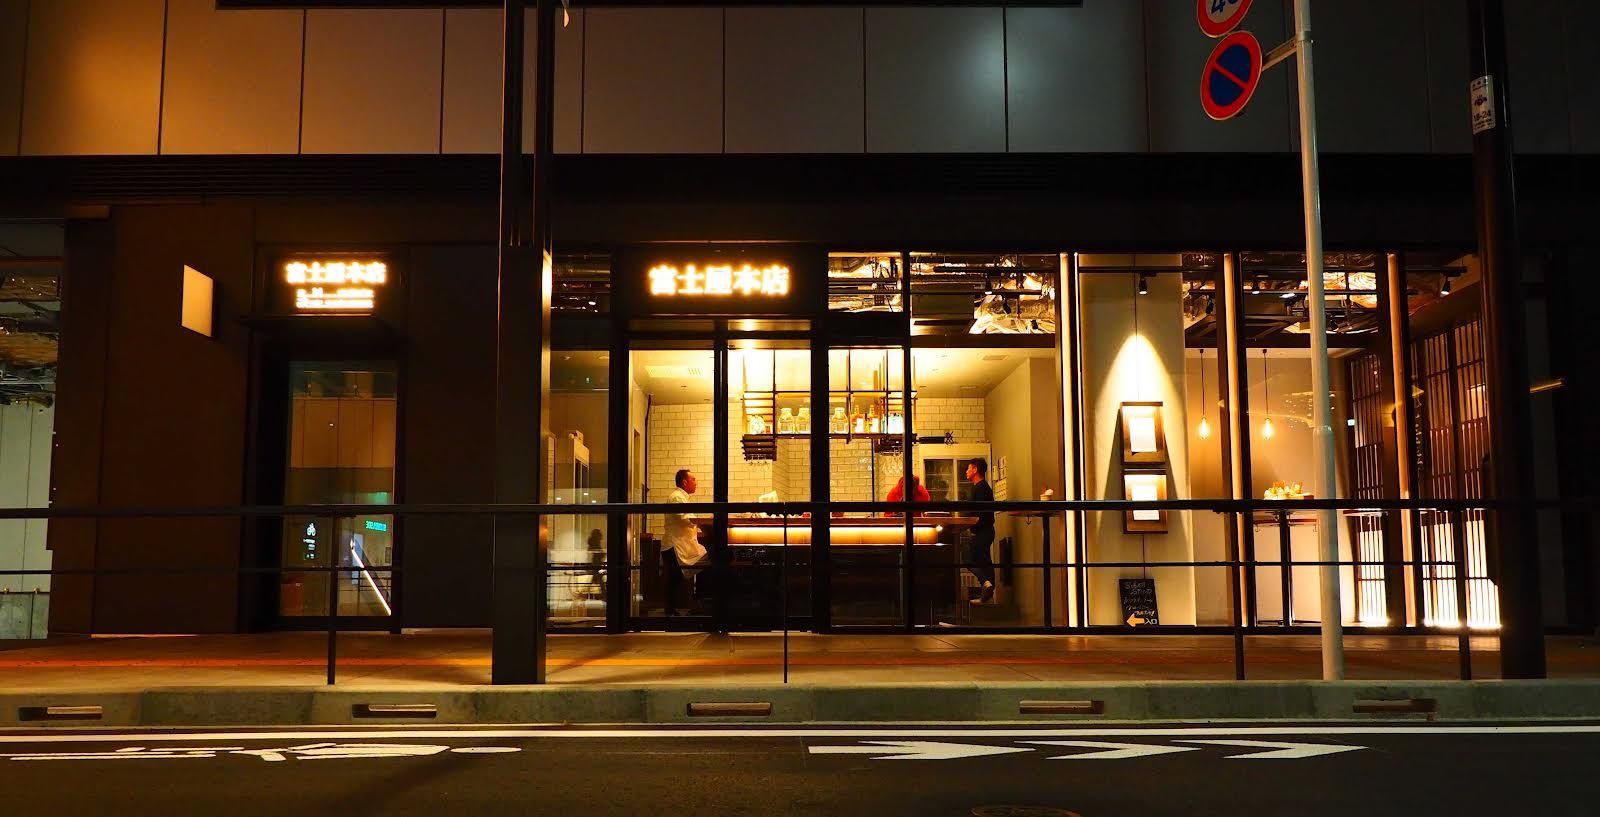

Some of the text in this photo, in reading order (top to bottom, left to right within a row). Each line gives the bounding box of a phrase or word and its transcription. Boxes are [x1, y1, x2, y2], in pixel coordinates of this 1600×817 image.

[1210, 0, 1238, 13] 4
[648, 264, 789, 296] 富士屋本店
